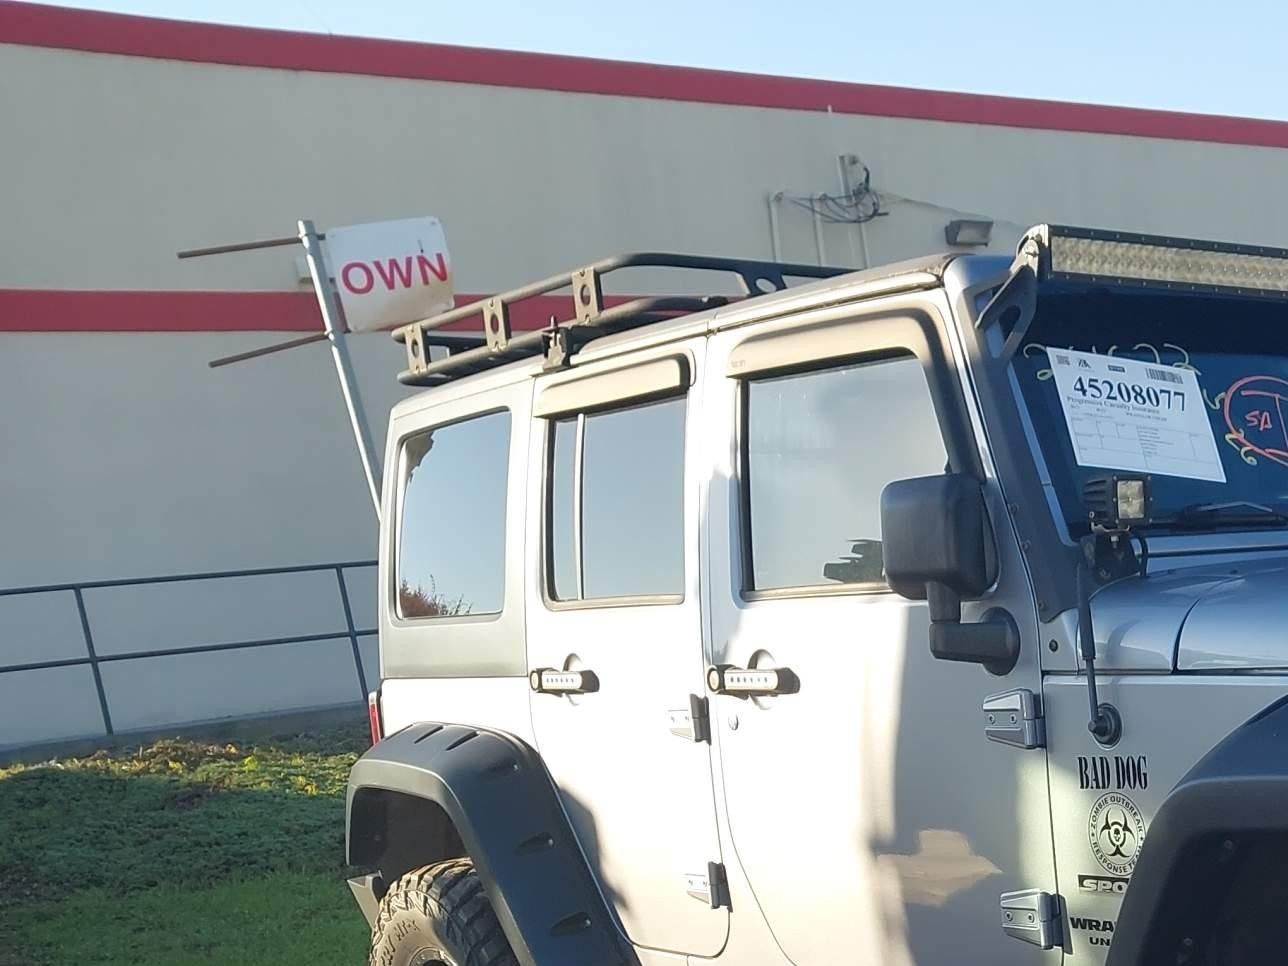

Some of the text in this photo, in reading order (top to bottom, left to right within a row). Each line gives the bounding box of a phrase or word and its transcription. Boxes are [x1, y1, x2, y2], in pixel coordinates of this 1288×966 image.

[341, 252, 448, 295] OWN
[1073, 376, 1186, 412] 45208077
[1077, 755, 1149, 790] BAD DOG
[1090, 795, 1144, 832] ZOMBIE OUTBREAK
[1091, 841, 1129, 874] RESPONSE
[1069, 917, 1118, 933] WRA
